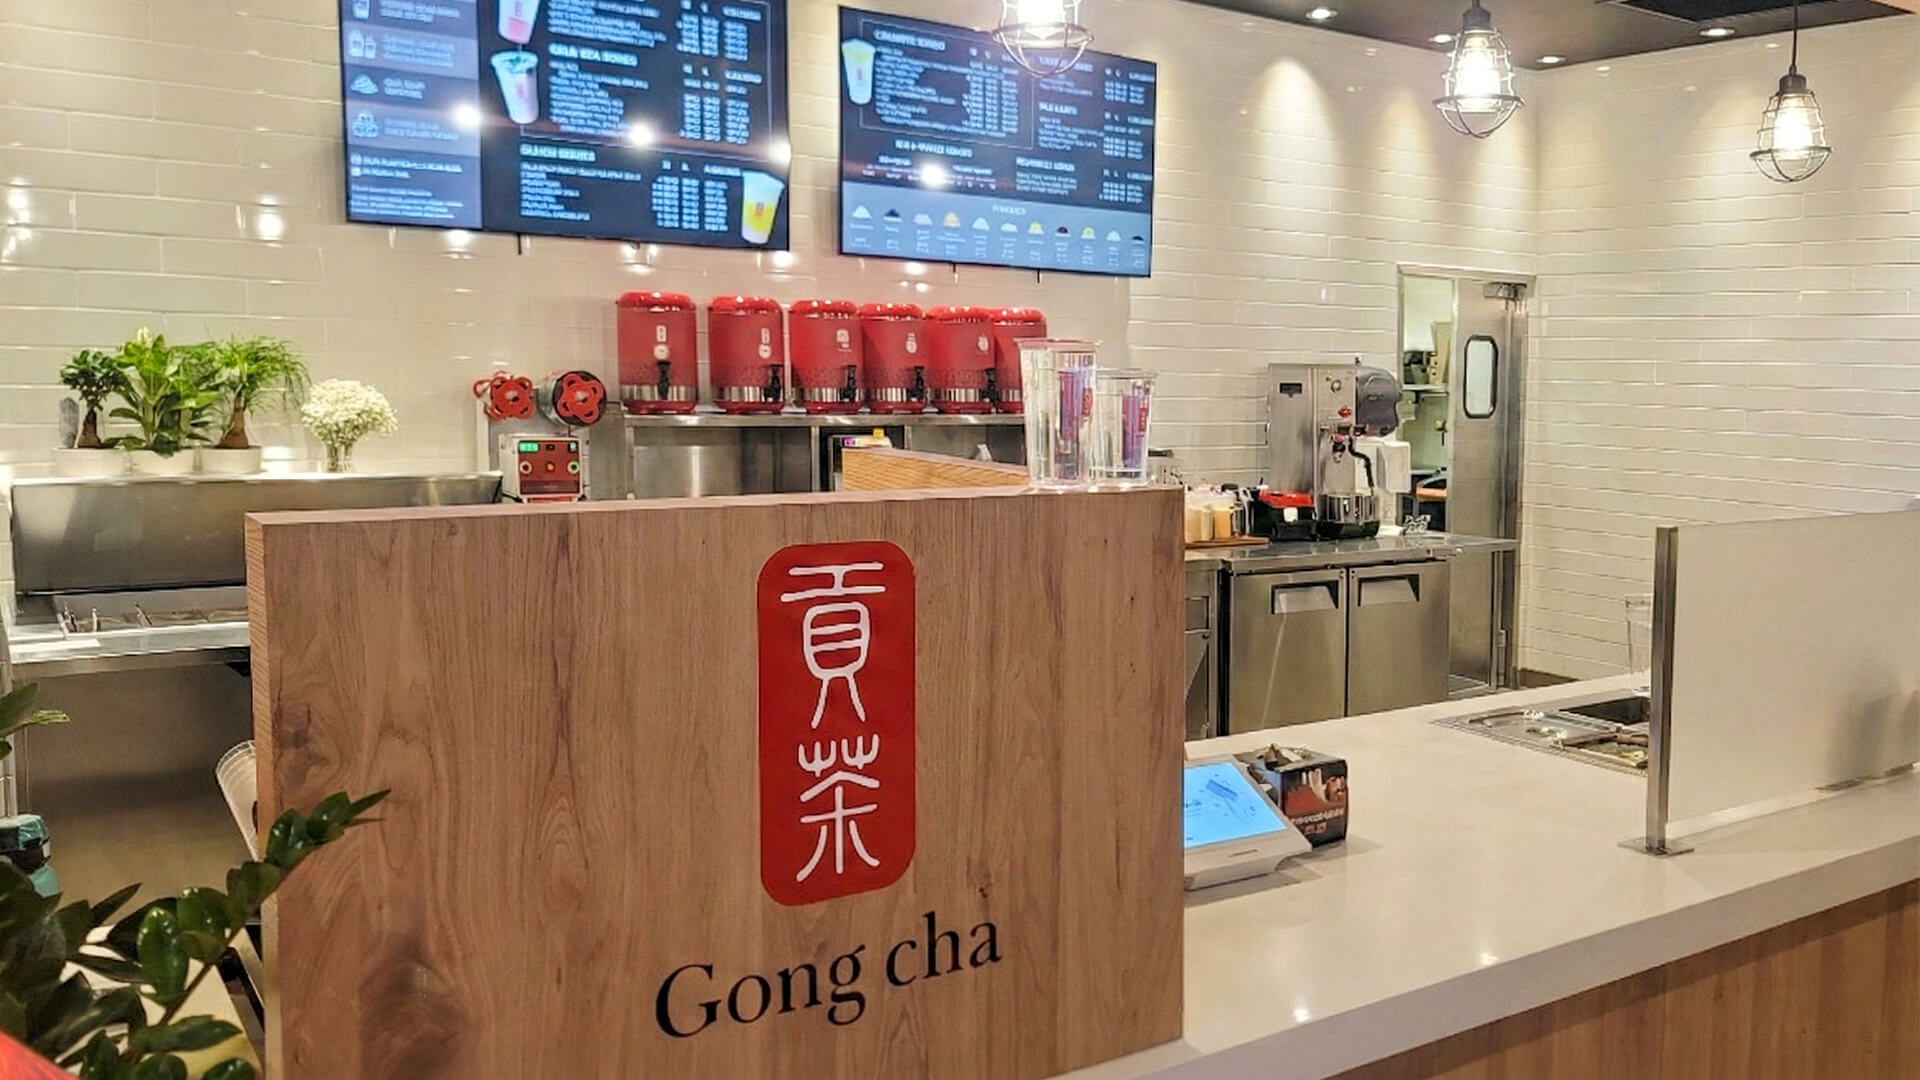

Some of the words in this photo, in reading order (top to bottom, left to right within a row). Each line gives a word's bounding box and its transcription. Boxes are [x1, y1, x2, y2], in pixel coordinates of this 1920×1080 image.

[780, 562, 886, 882] 貢茶
[655, 943, 867, 1038] Gong
[886, 911, 1002, 988] cha
